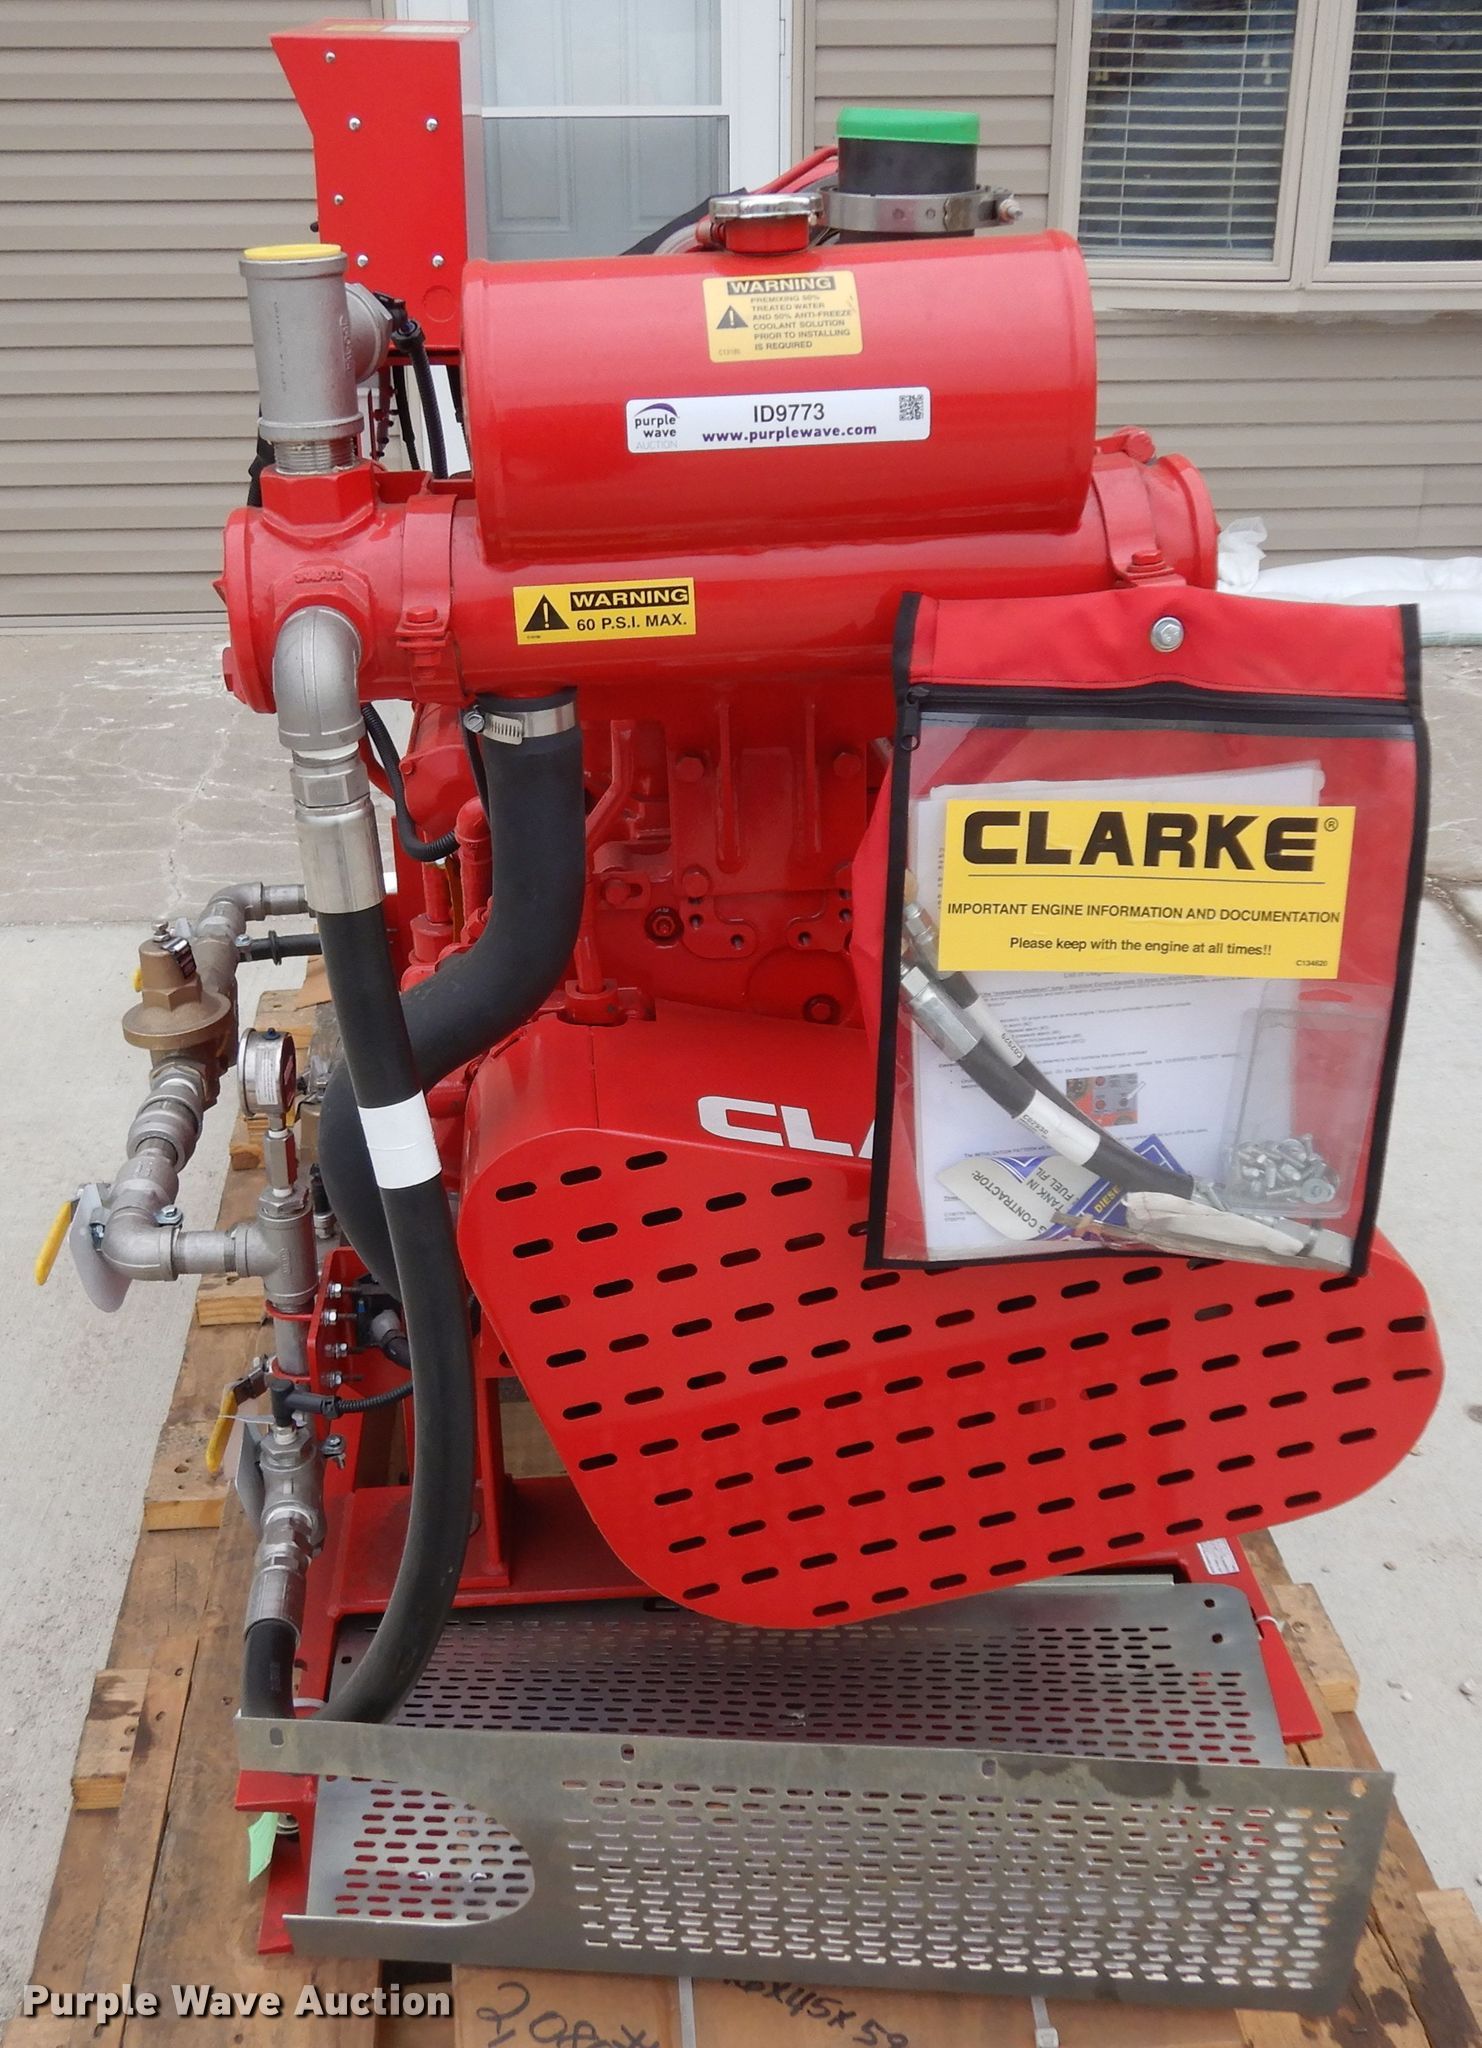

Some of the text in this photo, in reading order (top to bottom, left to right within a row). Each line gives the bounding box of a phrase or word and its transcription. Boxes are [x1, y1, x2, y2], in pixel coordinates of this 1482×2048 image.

[729, 276, 833, 294] WARNING
[752, 304, 792, 312] TREATED
[753, 313, 772, 321] AND
[794, 309, 852, 319] ANTI-FREEZE
[753, 319, 846, 330] COOLANT SOLUTION
[754, 329, 851, 340] PRIOR TO INSTALLING
[755, 340, 813, 351] IS REQUIRED
[634, 414, 677, 429] purple
[753, 403, 825, 423] ID9773
[643, 428, 677, 438] wave
[702, 423, 877, 443] www.purplewave.com
[636, 440, 678, 450] AUCTION
[571, 588, 689, 608] WARNING
[577, 613, 687, 631] 60 P.S.I. MAX.
[948, 903, 1340, 923] IMPORTANT ENGINE INFORMATION AND DOCUMENTATION
[1010, 937, 1272, 955] Please keep with the engine at all times!!
[1050, 1177, 1074, 1202] FUEL
[971, 1170, 1038, 1228] CONTRACTOR:
